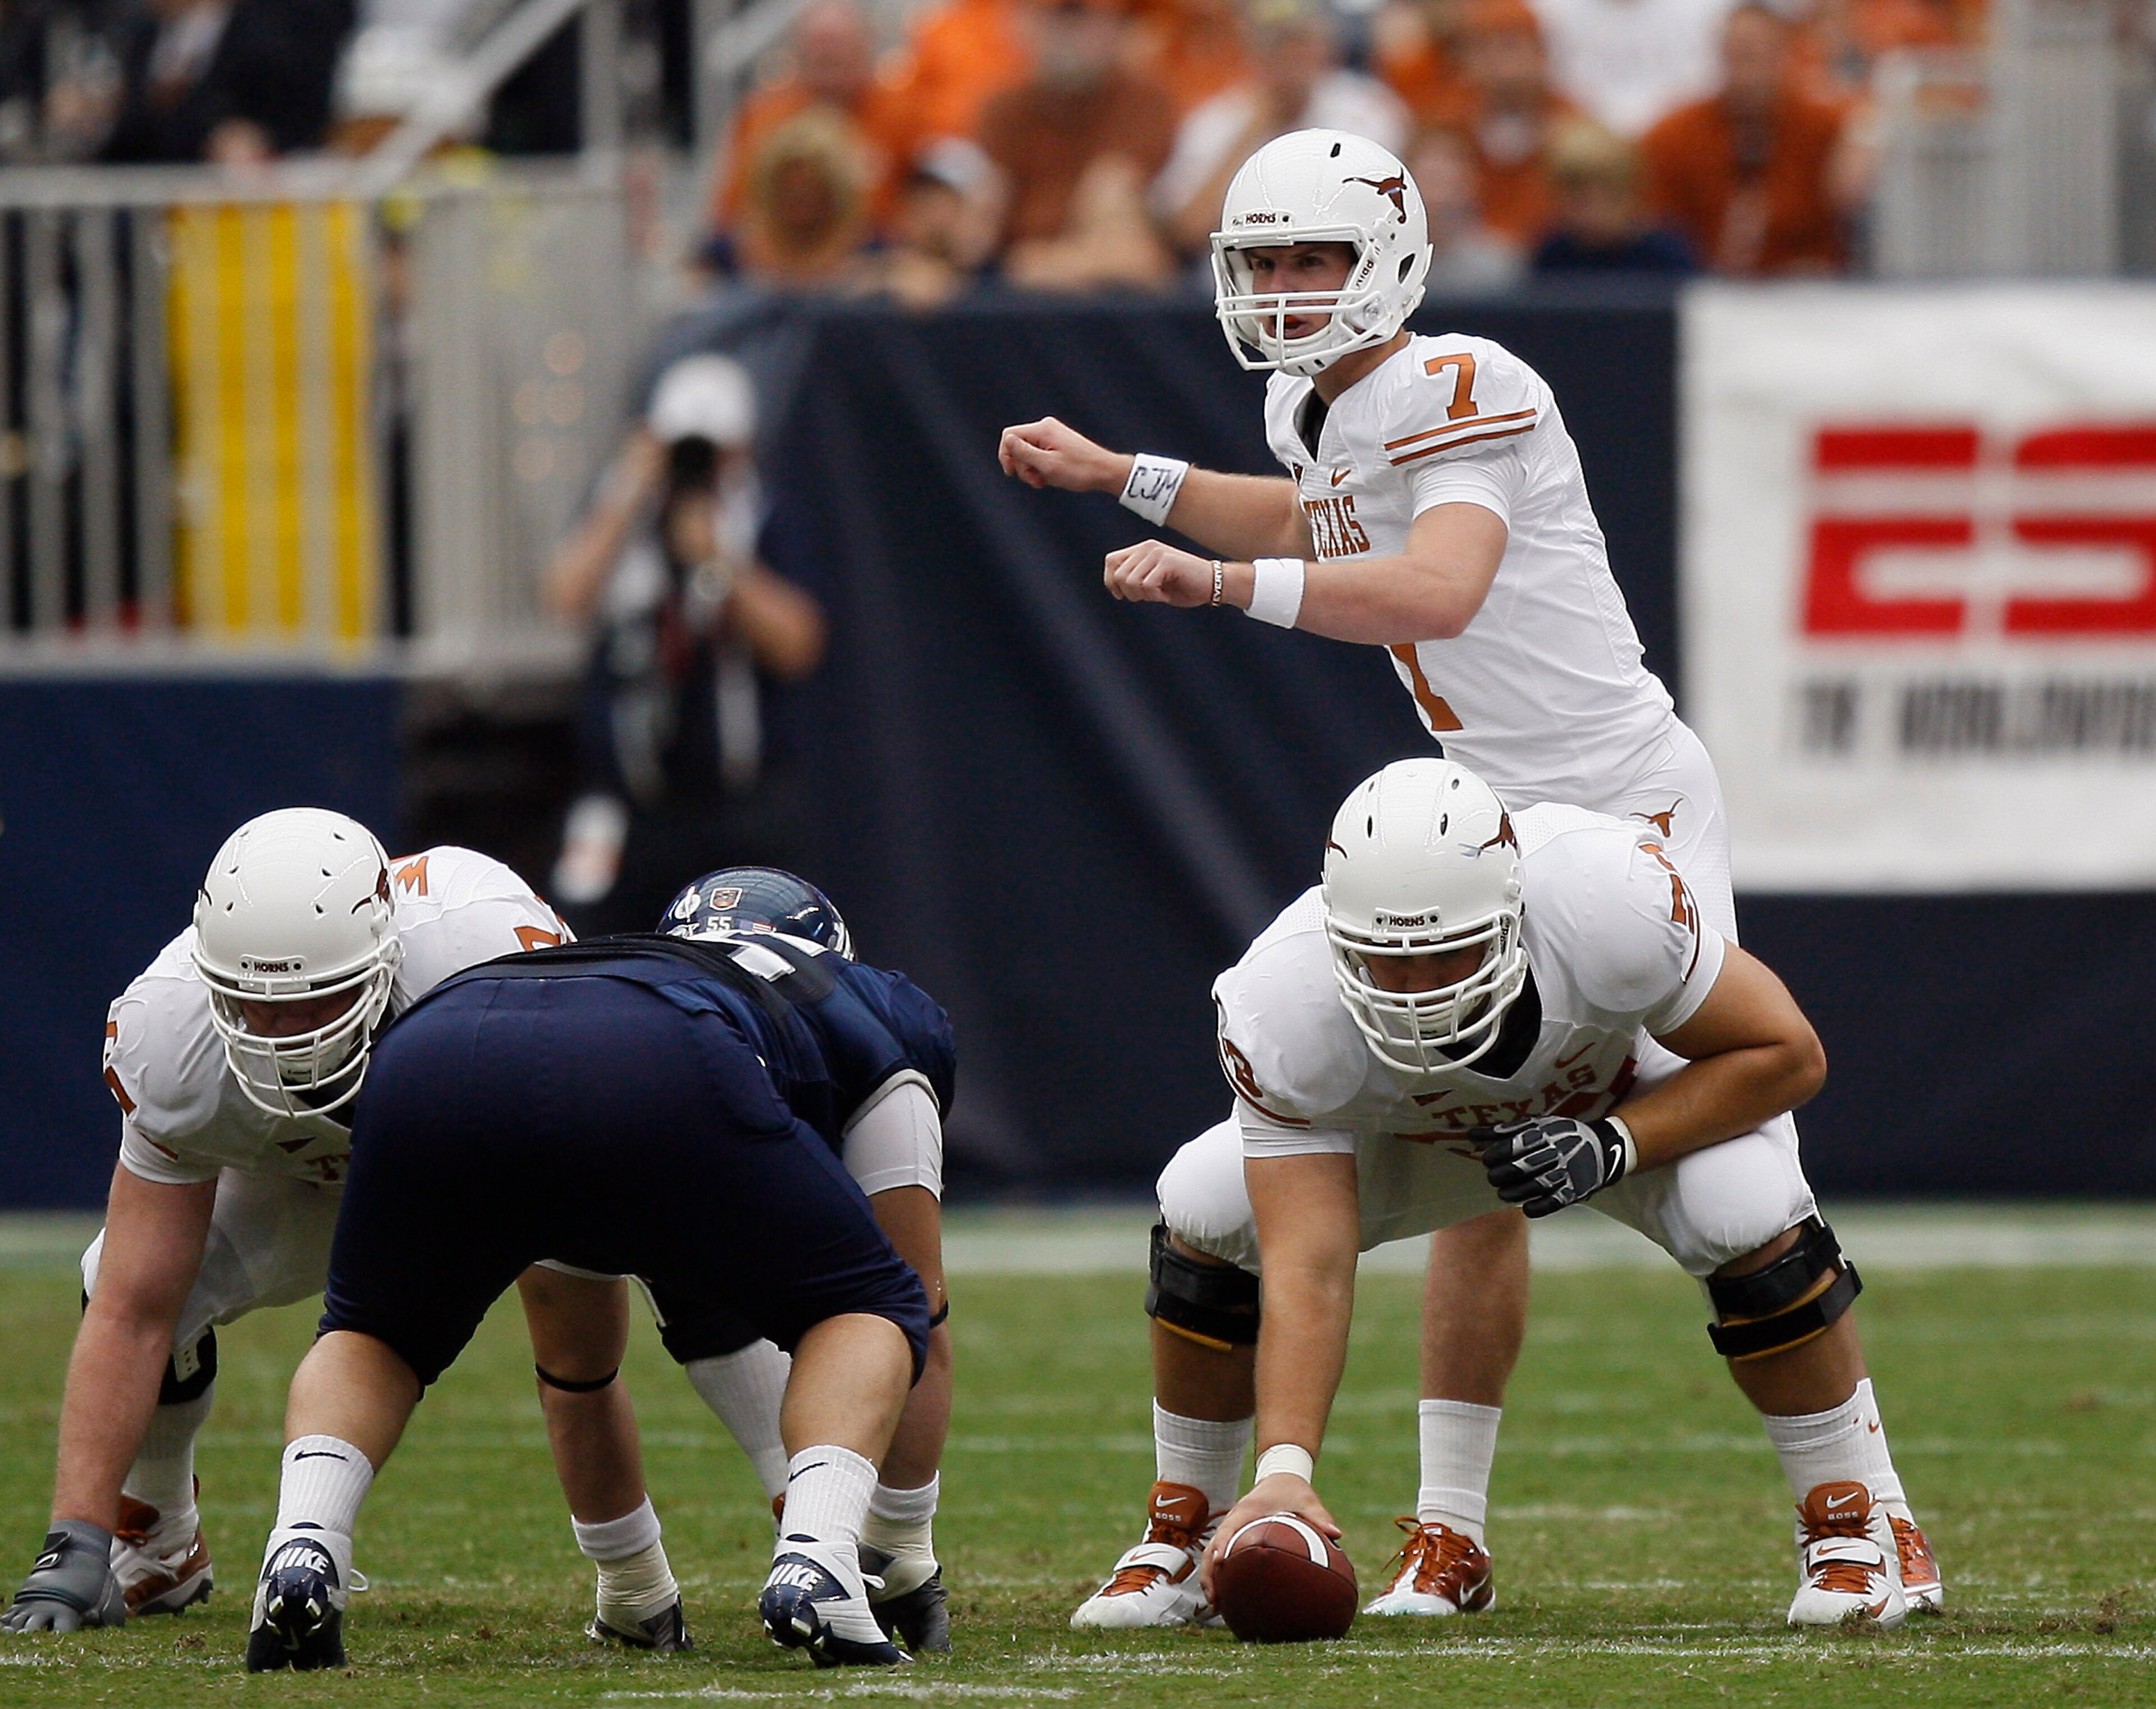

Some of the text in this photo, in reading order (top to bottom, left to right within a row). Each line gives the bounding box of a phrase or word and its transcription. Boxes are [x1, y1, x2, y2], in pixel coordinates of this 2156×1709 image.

[1245, 213, 1276, 224] HORNS
[1424, 353, 1478, 420] 7
[706, 916, 732, 931] 55
[1389, 916, 1426, 927] HORNS
[254, 961, 289, 973] HORNS
[1432, 1062, 1598, 1128] TEXAS
[268, 1546, 329, 1577] NIKE
